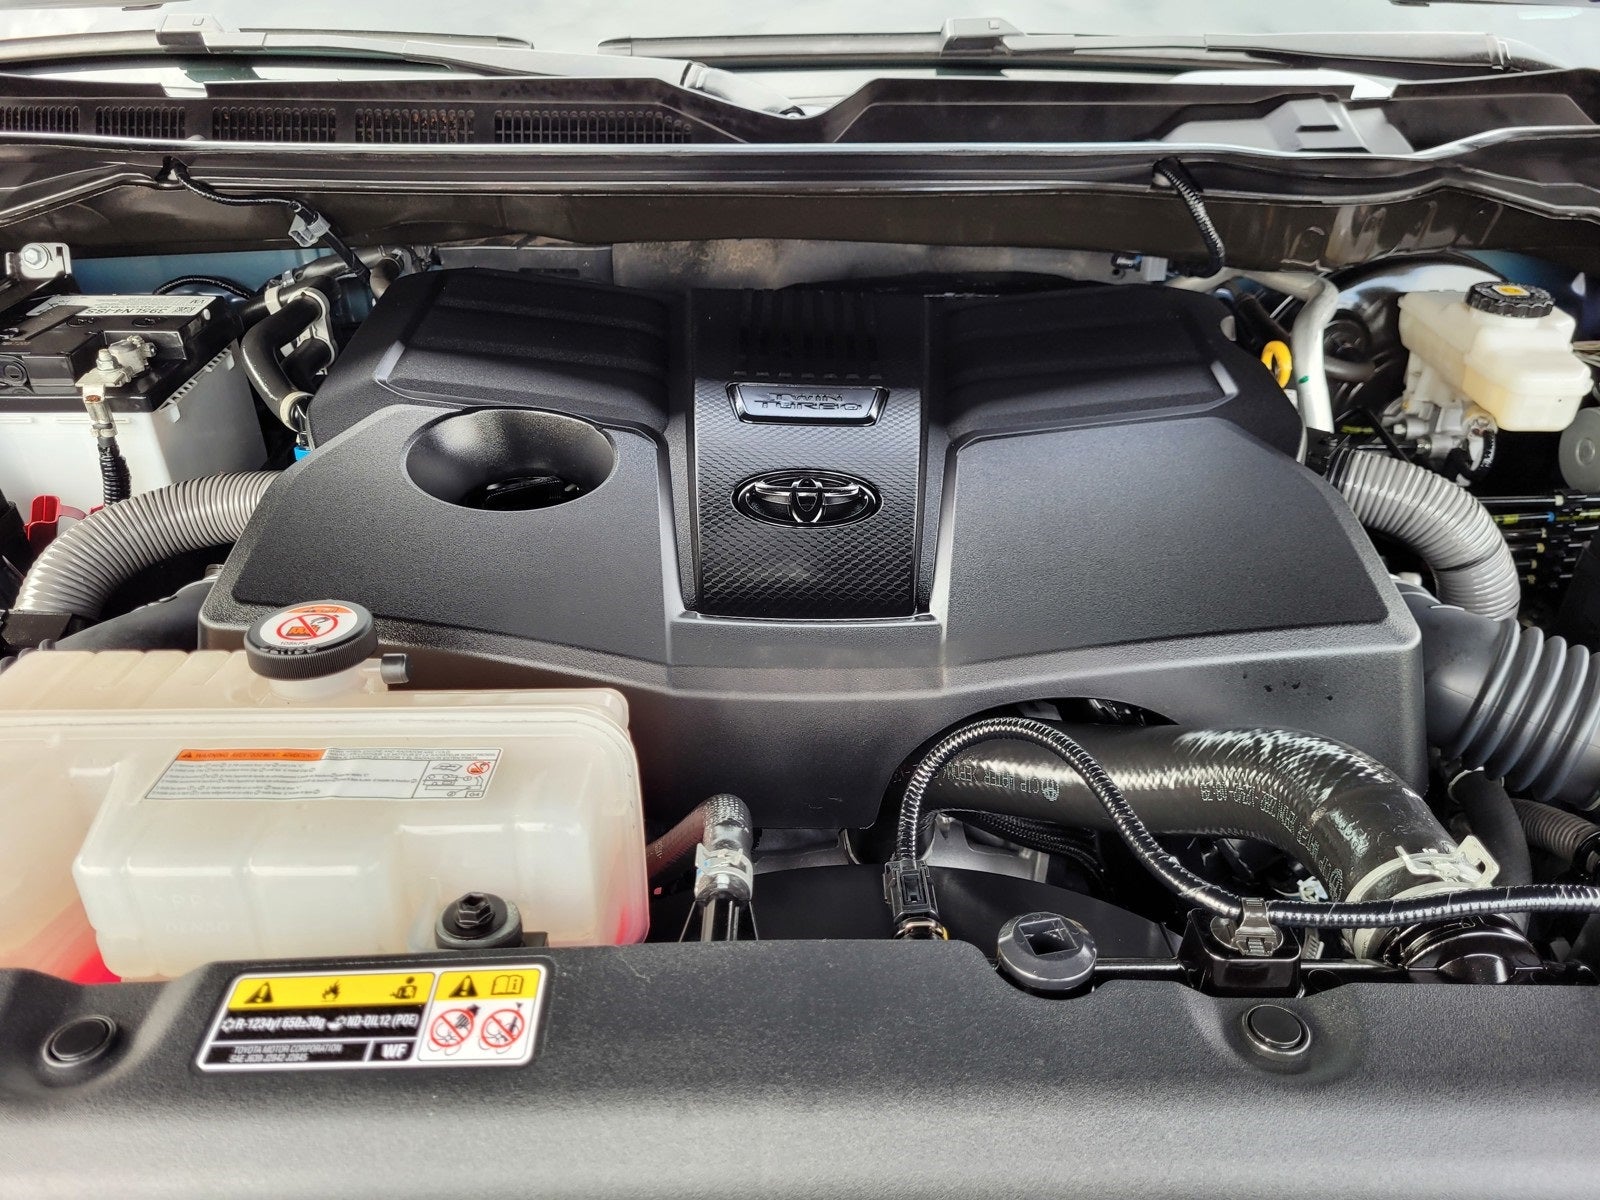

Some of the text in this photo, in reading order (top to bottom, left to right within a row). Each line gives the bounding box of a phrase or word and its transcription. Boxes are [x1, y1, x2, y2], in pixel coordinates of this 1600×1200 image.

[754, 400, 863, 411] TURBO
[392, 1013, 419, 1029] (POE)
[234, 1043, 344, 1055] TOYOTA MOTOR CORPORATION
[381, 1043, 409, 1060] WF
